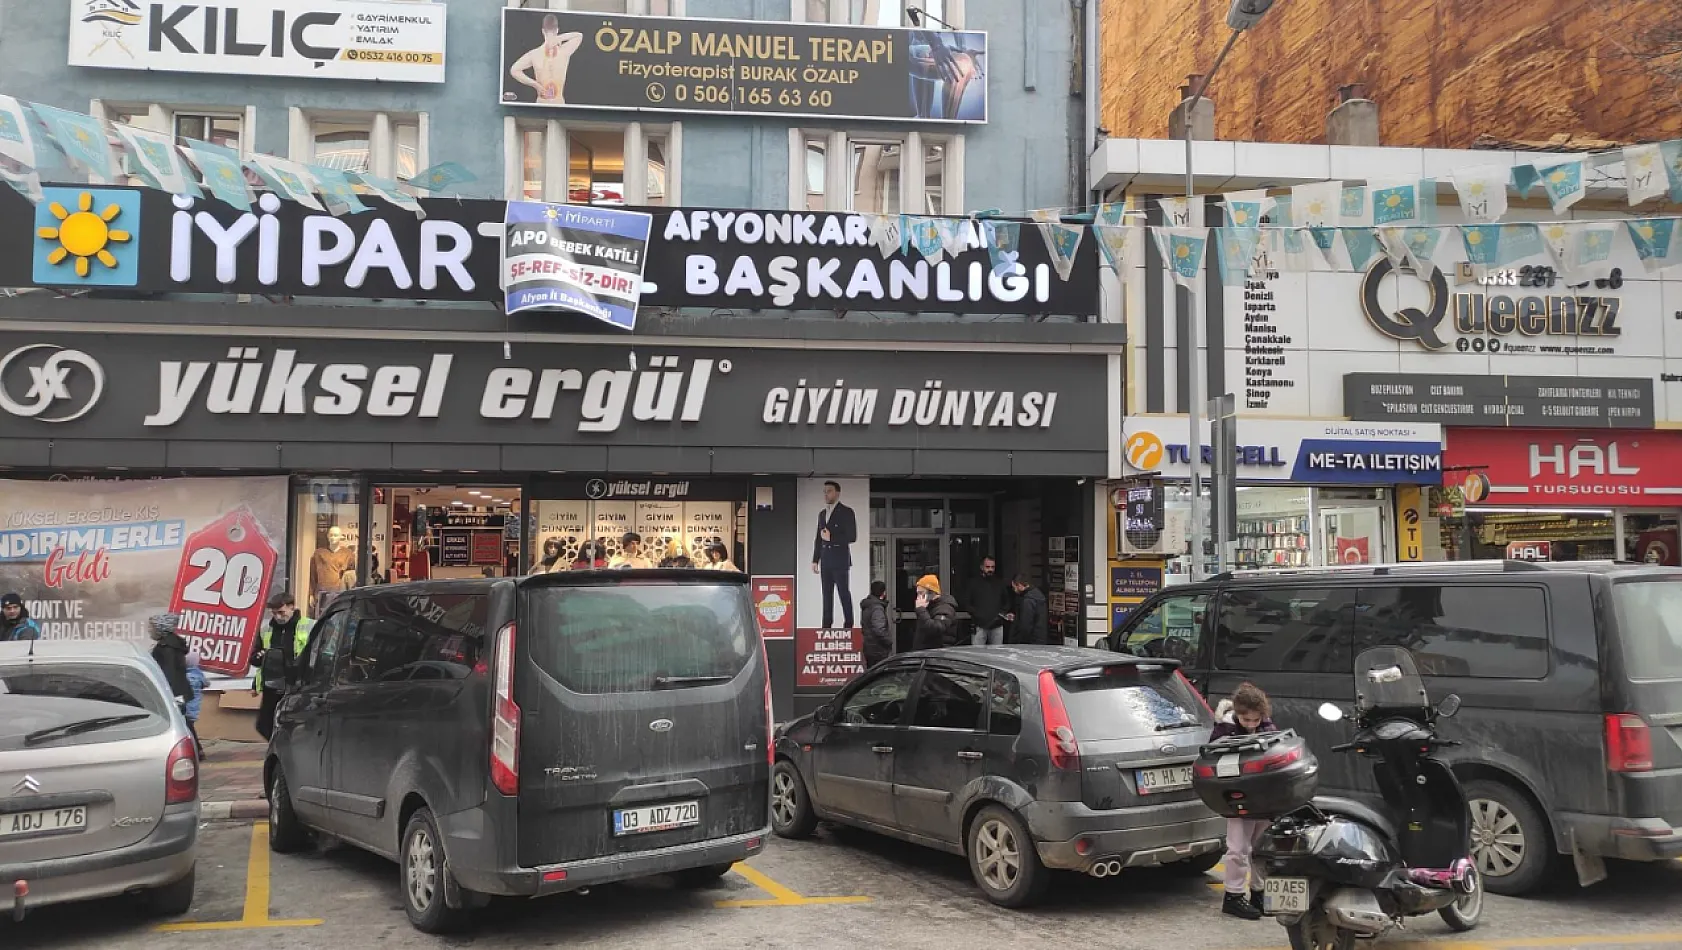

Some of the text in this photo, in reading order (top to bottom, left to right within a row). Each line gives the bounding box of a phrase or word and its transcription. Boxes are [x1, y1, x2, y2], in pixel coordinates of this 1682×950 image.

[356, 13, 432, 24] GAYRİMENKUL
[149, 4, 342, 69] KILIÇ
[356, 25, 399, 34] YATIRIM
[355, 36, 394, 45] EMLAK
[594, 21, 893, 64] ÖZALP MANUEL TERAPİ
[359, 52, 433, 63] 0532 416 00 75
[618, 60, 859, 84] Fizyoterapist BURAK ÖZALP
[675, 85, 832, 107] 0 506 165 63 60
[170, 193, 505, 293] İYİ PAR
[511, 230, 640, 265] APO BEBEK KATİLİ
[511, 260, 633, 294] ŞE-REF-SİZ-DİR!
[685, 250, 1051, 307] BAŞKANLIĞI
[521, 291, 548, 304] Afyon
[1244, 292, 1273, 301] Denizli
[1244, 313, 1269, 324] Aydın
[1245, 323, 1277, 333] Manisa
[1245, 334, 1292, 345] Çanakkale
[1246, 355, 1286, 365] Kırklareli
[1246, 367, 1272, 378] Konya
[144, 347, 713, 431] yüksel ergül
[1246, 377, 1294, 388] Kastamonu
[1247, 388, 1271, 400] Sinop
[762, 379, 1057, 428] GİYİM DÜNYASI
[1355, 428, 1376, 437] SATIŞ
[1377, 428, 1410, 437] NOKTASI
[1165, 444, 1287, 467] TURELL
[1309, 453, 1366, 469] ME-TA
[606, 481, 690, 497] yüksel ergül
[1533, 485, 1641, 495] TURŞUCUSU
[4, 509, 60, 528] YÜKSEL
[132, 505, 160, 521] KIŞ
[44, 547, 112, 589] Geldi
[64, 600, 84, 619] VE
[177, 609, 248, 639] İNDİRİM
[816, 630, 852, 640] TAKIM
[178, 634, 242, 665] RSATI
[814, 641, 853, 651] ELBİSE
[805, 652, 861, 665] ÇEŞİTLERİ
[802, 665, 864, 674] ALT KATTA
[1143, 771, 1157, 786] 03
[1163, 769, 1176, 784] HA
[12, 808, 84, 833] ADJ 176
[622, 812, 638, 829] 03
[649, 808, 671, 826] ADZ
[675, 804, 697, 822] 720
[1266, 880, 1306, 894] 03 AES
